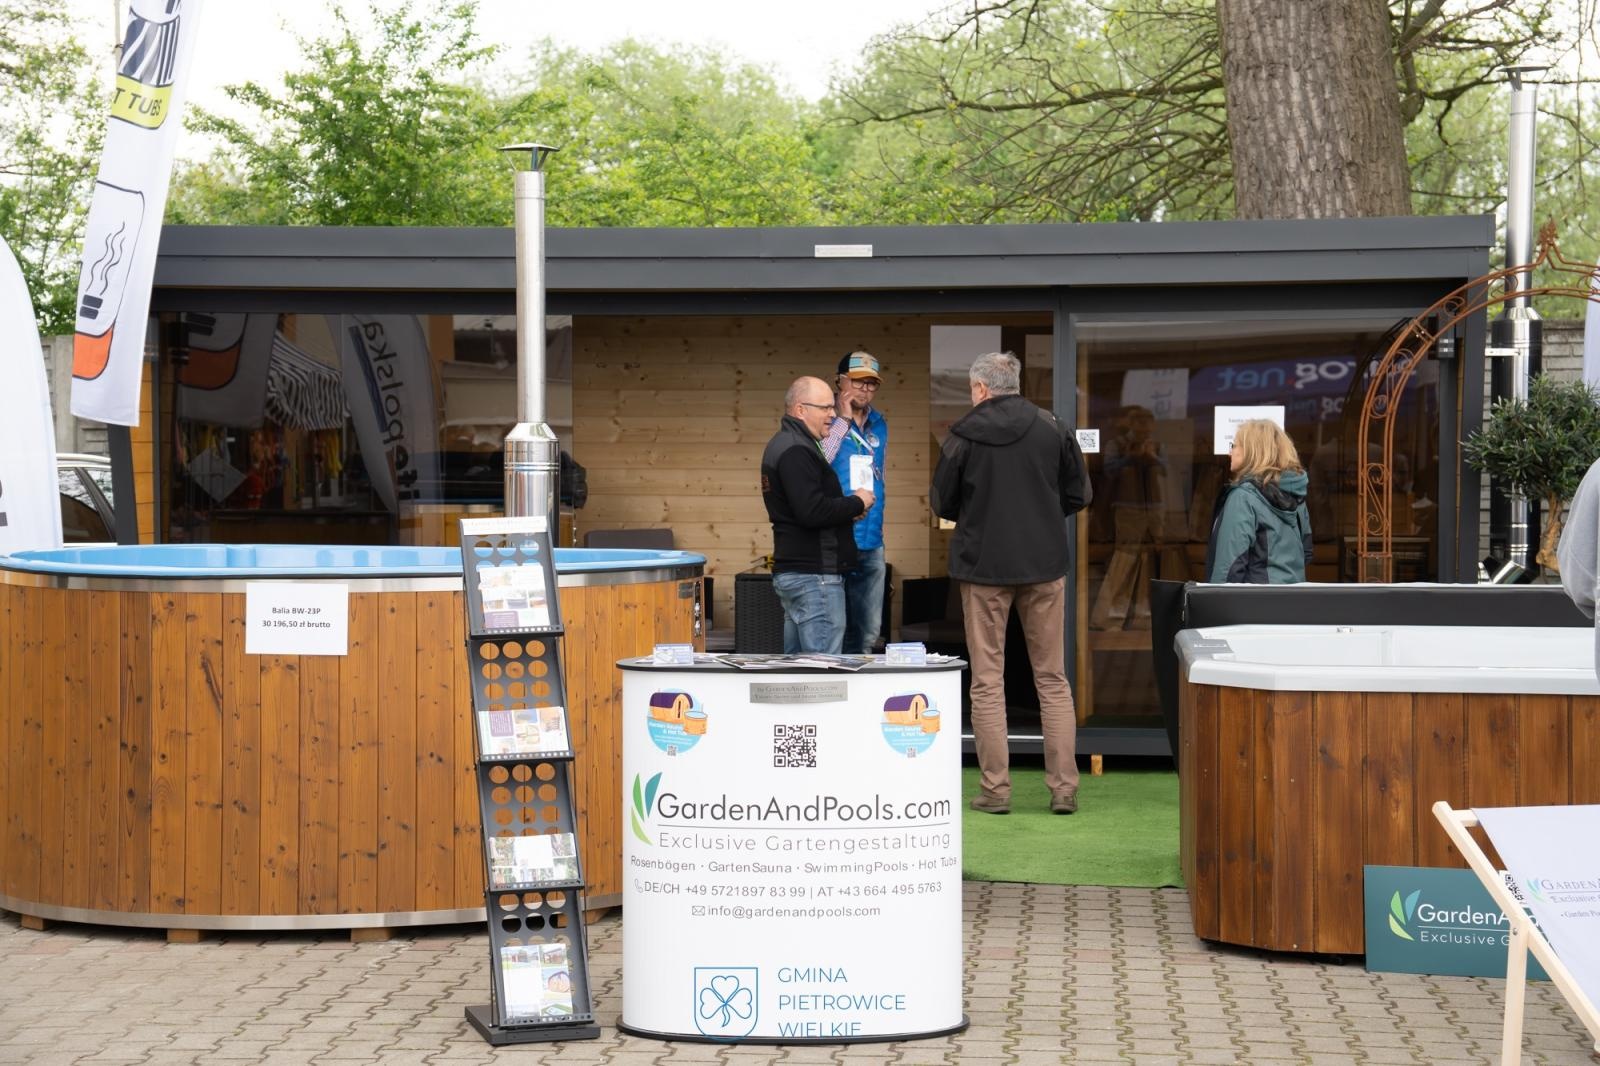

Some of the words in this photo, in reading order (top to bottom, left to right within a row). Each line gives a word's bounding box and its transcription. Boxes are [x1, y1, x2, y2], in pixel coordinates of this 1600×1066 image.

[127, 92, 163, 116] TUBS
[291, 607, 321, 615] BW-23P
[262, 620, 272, 628] 30
[273, 620, 298, 629] 196,50
[306, 620, 331, 628] brutto
[656, 792, 951, 822] GardenAndPools.com
[659, 832, 757, 851] Exclusive
[764, 832, 951, 854] Gartengestaltung
[630, 855, 696, 873] Rosenbögen
[708, 860, 792, 873] GartenSauna
[804, 860, 909, 875] SwimmingPools
[917, 859, 937, 871] Hot
[940, 856, 958, 868] Tubs
[643, 881, 681, 895] DE/CH
[685, 884, 707, 896] +49
[769, 886, 787, 898] 83
[789, 886, 806, 898] 99
[816, 886, 834, 897] AT
[837, 885, 861, 897] +43
[863, 884, 887, 897] 664
[891, 883, 915, 896] 495
[917, 881, 942, 894] 5763
[707, 905, 881, 919] info@gardenandpools.com
[1417, 903, 1511, 926] GardenA
[1419, 930, 1496, 946] Exclusive
[777, 967, 849, 983] GMINA
[778, 994, 907, 1011] PIETROWICE
